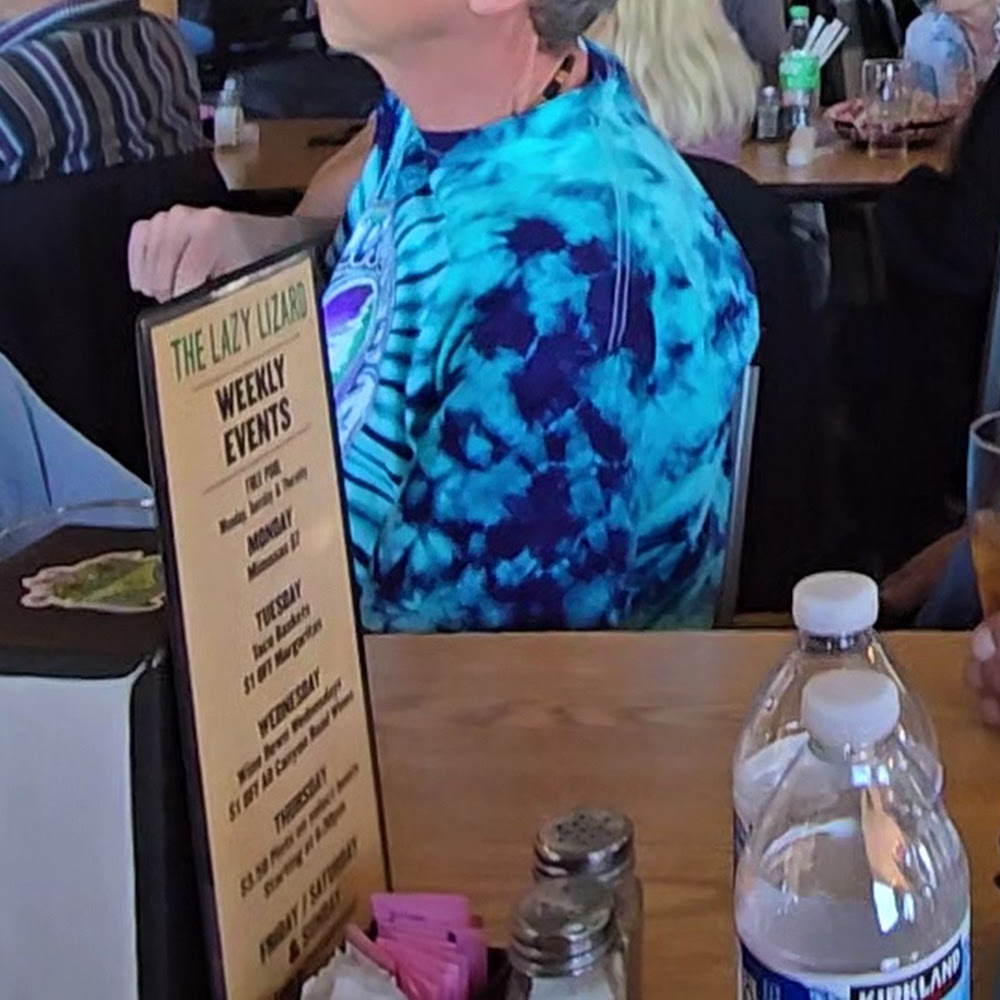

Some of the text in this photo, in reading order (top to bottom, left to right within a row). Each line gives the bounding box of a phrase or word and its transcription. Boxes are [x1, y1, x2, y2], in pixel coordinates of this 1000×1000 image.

[170, 279, 308, 383] THE LAZY LIZARD
[215, 353, 287, 424] WEEKLY
[223, 394, 291, 466] EVENTS
[246, 506, 293, 557] MONDAY
[255, 578, 302, 633] TUESDAY
[258, 666, 320, 740] WEDNESDAY
[274, 764, 327, 835] THURSDAY
[259, 903, 299, 965] FRIDAY
[309, 834, 357, 906] SATURDAY
